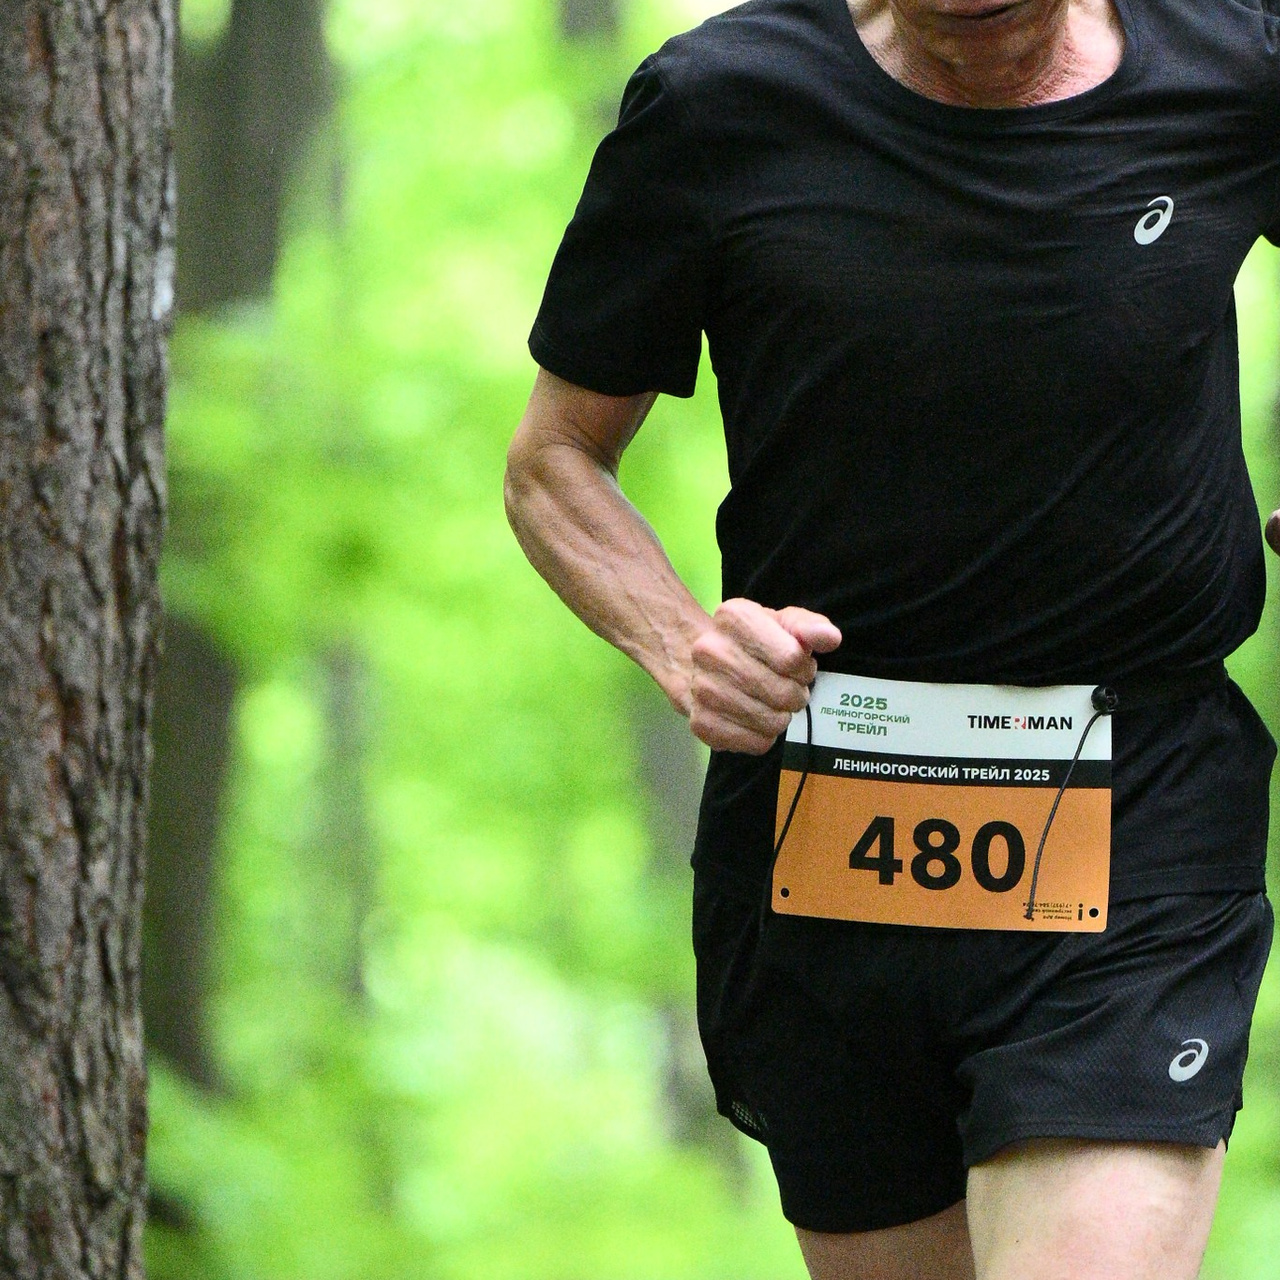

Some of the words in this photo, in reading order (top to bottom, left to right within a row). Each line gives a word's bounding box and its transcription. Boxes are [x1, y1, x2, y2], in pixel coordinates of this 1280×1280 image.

[839, 693, 888, 710] 2025
[820, 706, 910, 724] ЛЕНИНОГОРСКИЙ
[837, 720, 888, 736] ТРЕЙЛ
[833, 757, 959, 780] ЛЕНИНОГОРСКИЙ
[962, 765, 1011, 781] ТРЕЙЛ
[1014, 768, 1051, 782] 2025
[848, 815, 1026, 893] 480
